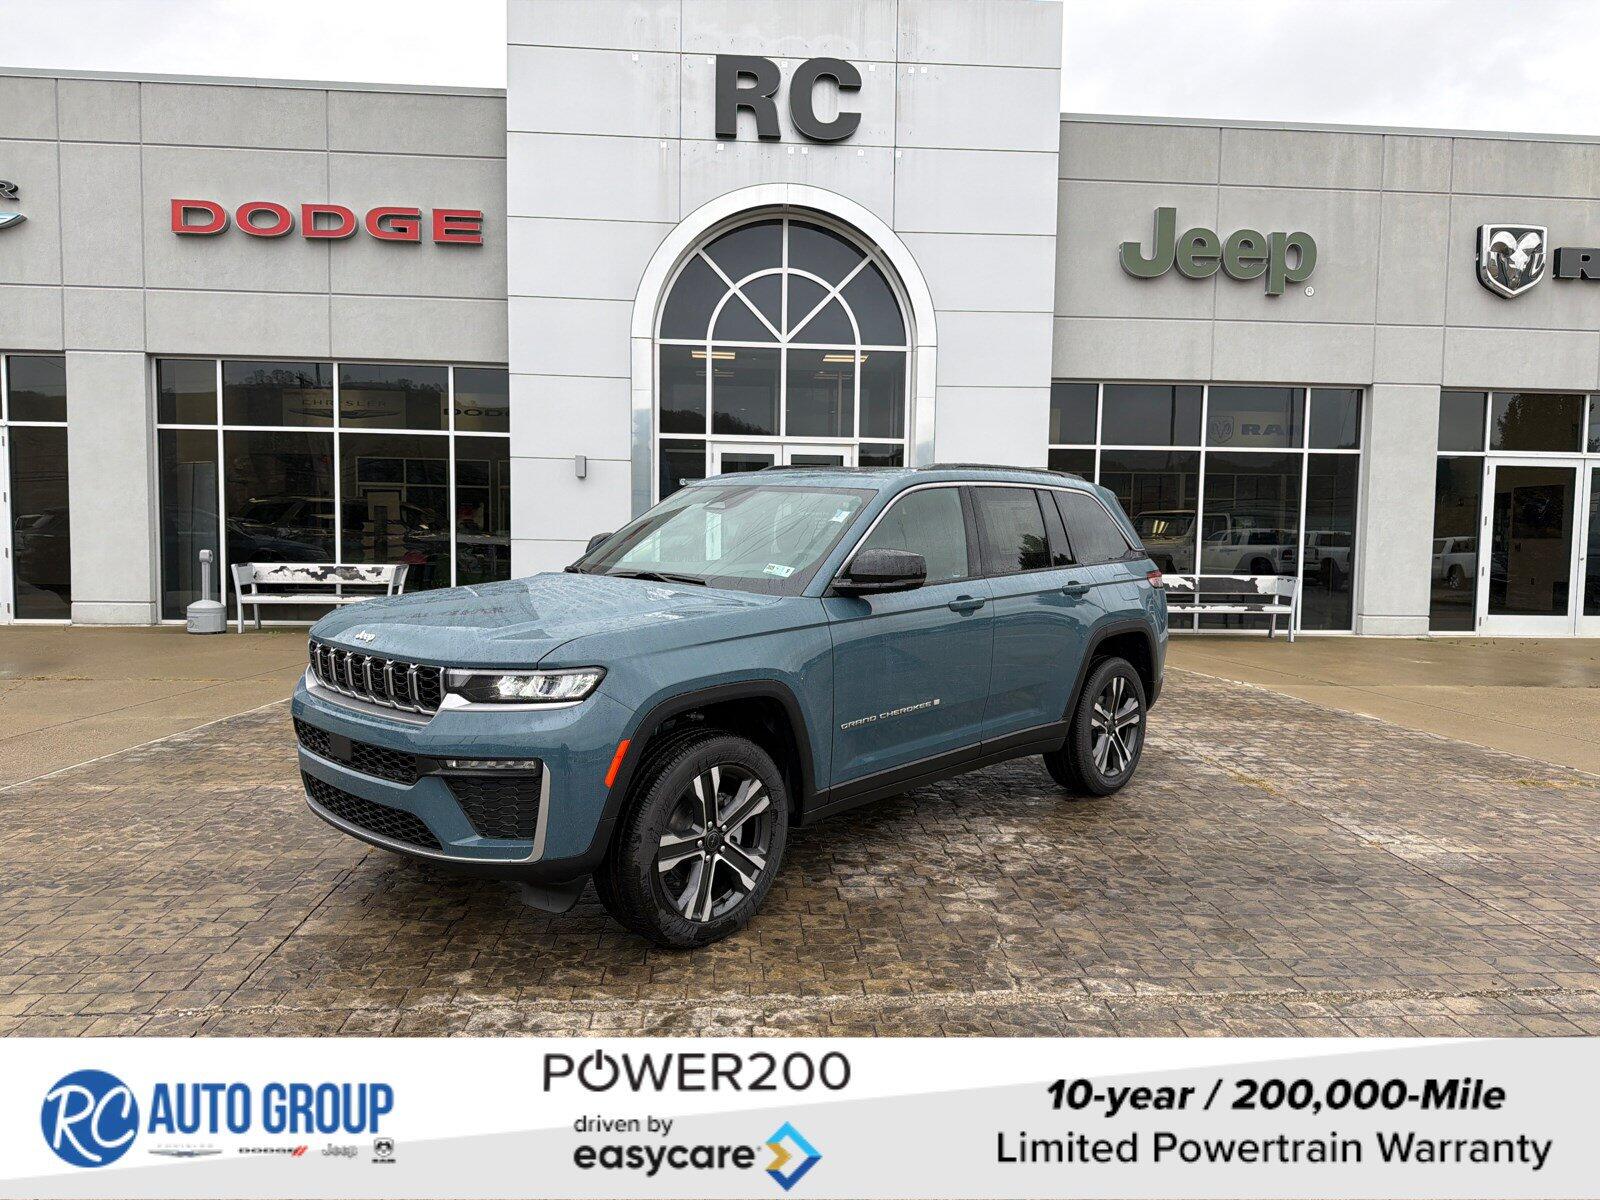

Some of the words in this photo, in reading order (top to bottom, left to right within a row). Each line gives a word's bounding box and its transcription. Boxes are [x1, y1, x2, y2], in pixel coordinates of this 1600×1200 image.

[714, 54, 863, 143] RC
[170, 198, 484, 246] DODGE
[1119, 206, 1318, 297] Jeep
[302, 399, 387, 407] CHRSLER
[355, 629, 376, 643] Jeep
[840, 715, 877, 730] GRAND
[879, 701, 932, 719] CHEROKEE
